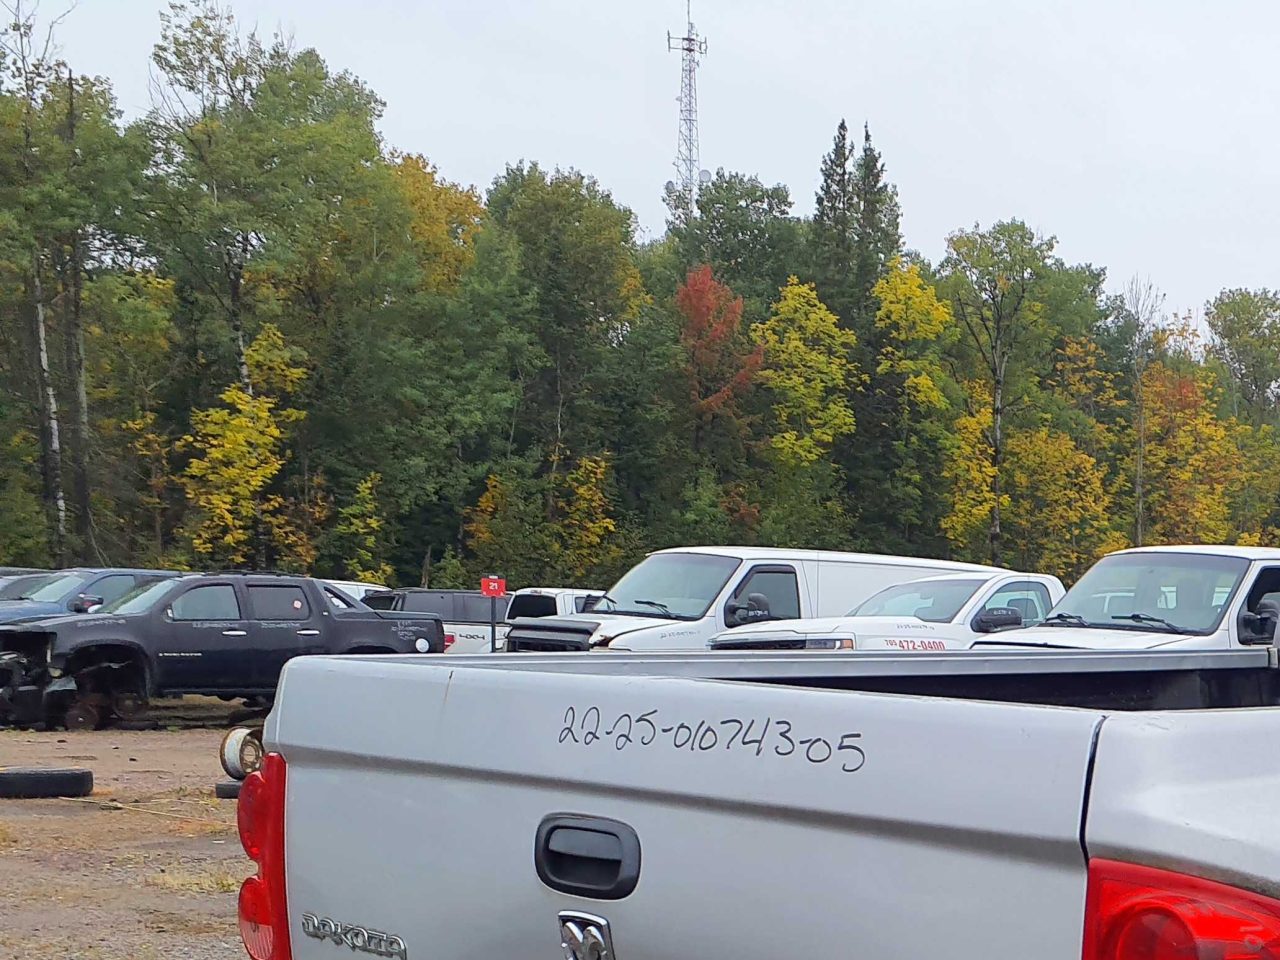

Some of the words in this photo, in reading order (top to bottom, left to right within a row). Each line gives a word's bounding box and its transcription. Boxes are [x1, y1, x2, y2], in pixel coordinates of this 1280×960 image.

[489, 582, 498, 590] 21
[898, 640, 946, 651] 472-0400
[558, 705, 866, 773] 22-25-010743-05
